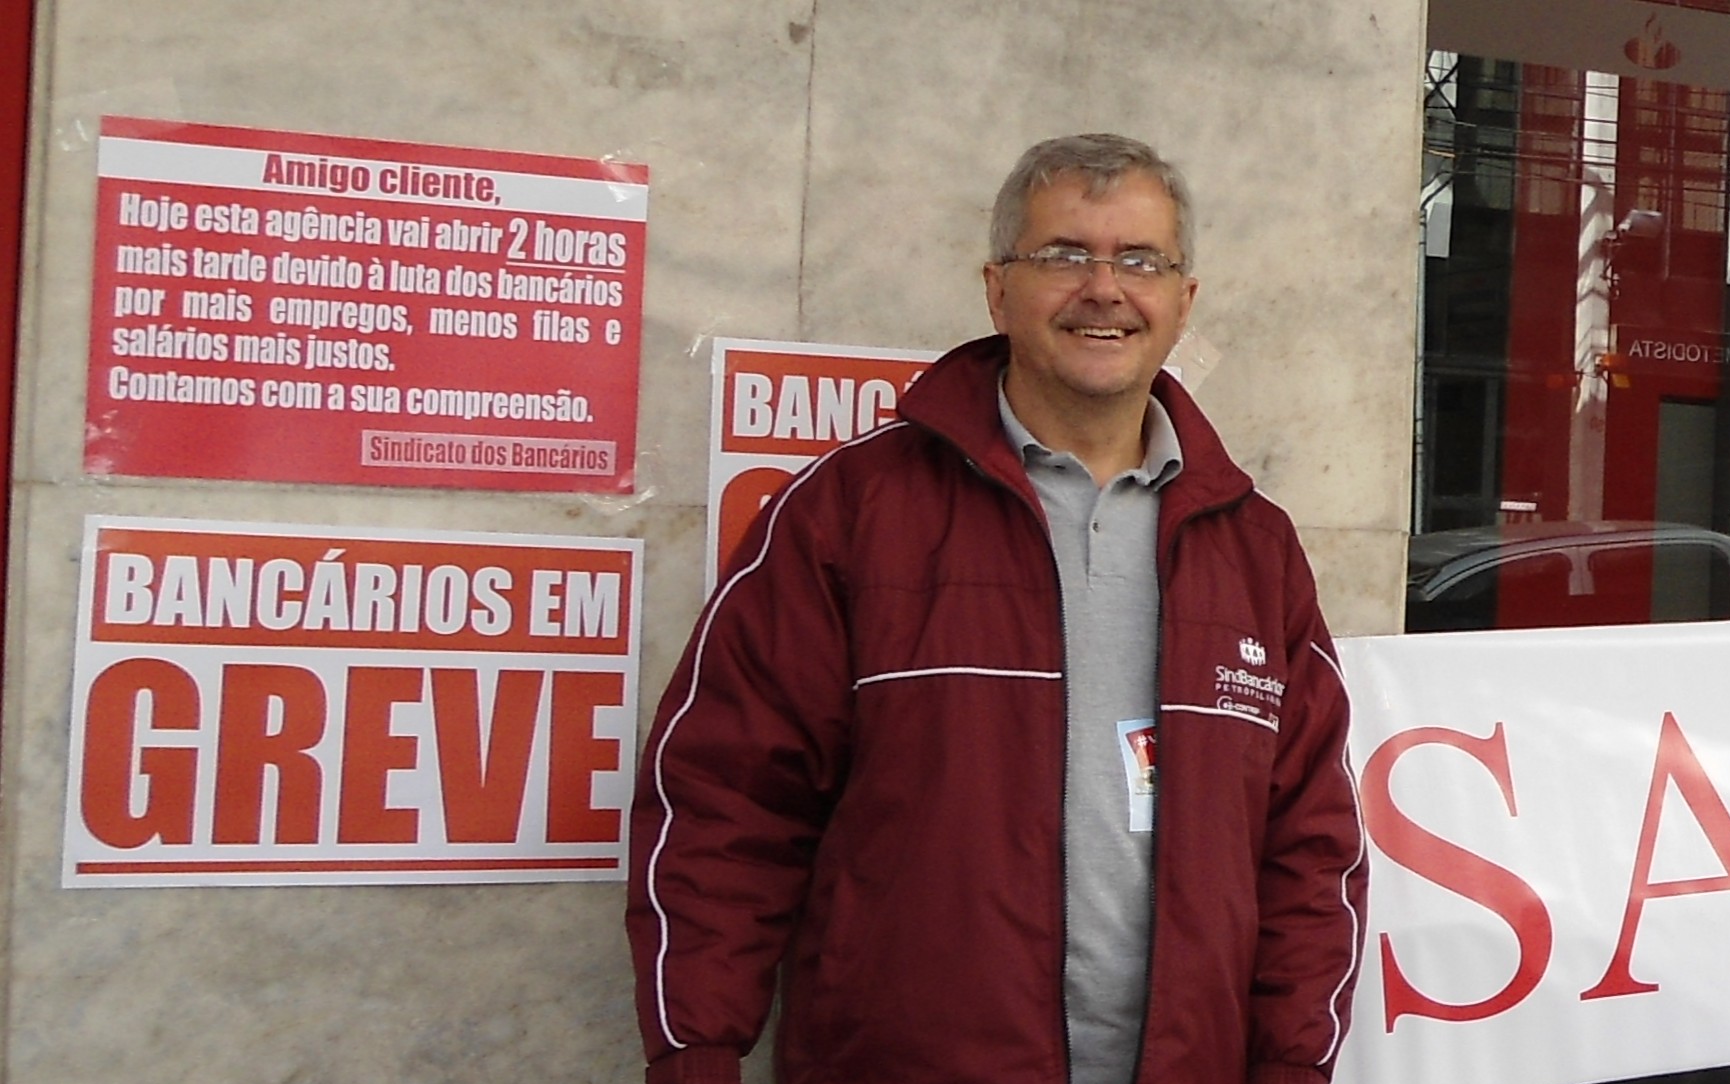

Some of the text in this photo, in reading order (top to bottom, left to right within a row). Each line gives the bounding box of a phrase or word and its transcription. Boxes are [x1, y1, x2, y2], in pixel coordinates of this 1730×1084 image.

[263, 152, 501, 206] Amigo cliente,
[119, 192, 626, 267] Hoje esta agência vai abrir 2 horas
[117, 244, 623, 308] mais tarde devido à luta dos bancários
[115, 286, 621, 346] por mais empregos, menos filas e
[112, 326, 395, 372] salários mais justos.
[109, 367, 594, 424] Contamos com a sua compreensão.
[733, 371, 924, 442] BANC
[370, 435, 608, 471] Sindicato dos Bancários
[104, 548, 621, 640] BANCÁRIOS EM
[80, 656, 626, 850] GREVE
